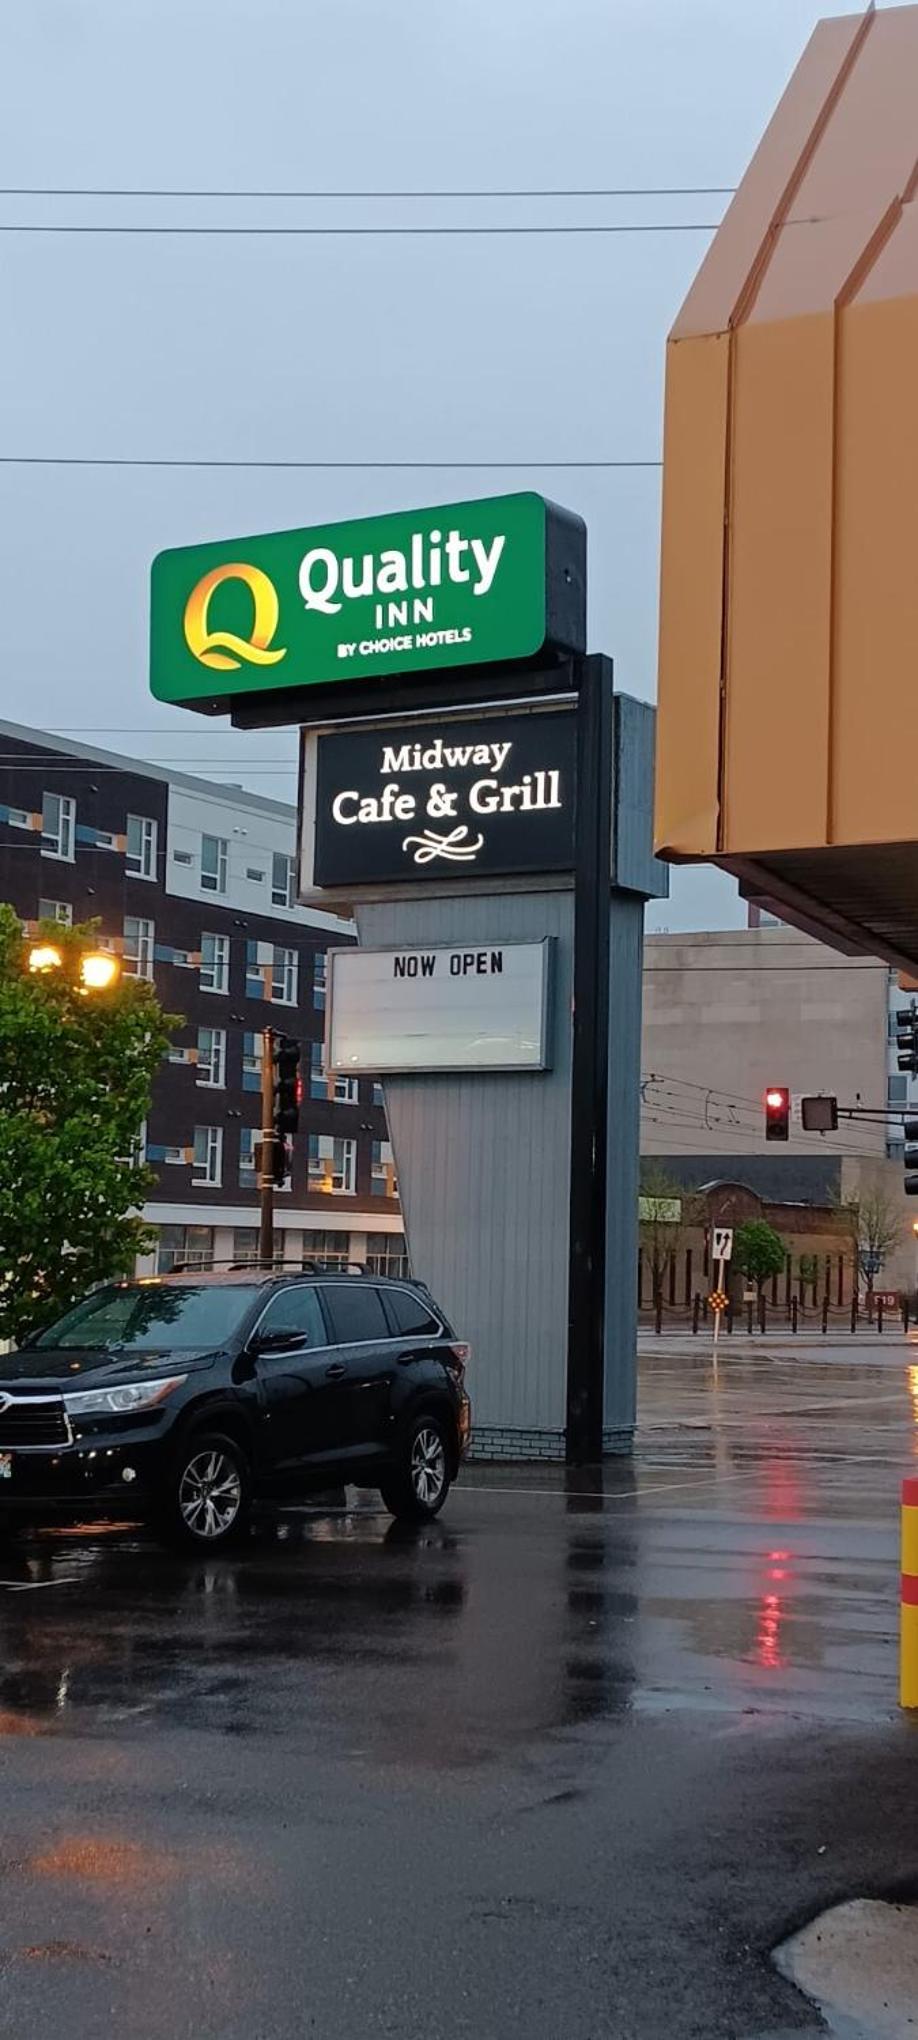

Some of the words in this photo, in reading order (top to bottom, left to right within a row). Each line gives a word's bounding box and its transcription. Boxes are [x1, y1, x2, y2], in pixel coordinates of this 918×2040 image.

[298, 529, 505, 614] Quality
[184, 562, 287, 670] Q
[375, 597, 434, 629] INN
[337, 643, 357, 658] BY
[358, 635, 413, 655] CHOICE
[415, 627, 472, 648] HOTELS
[379, 739, 513, 774] Midway
[332, 783, 416, 825] Cafe
[426, 783, 458, 818] &
[468, 770, 562, 814] Grill
[393, 955, 437, 978] NOW
[449, 951, 504, 976] OPEN
